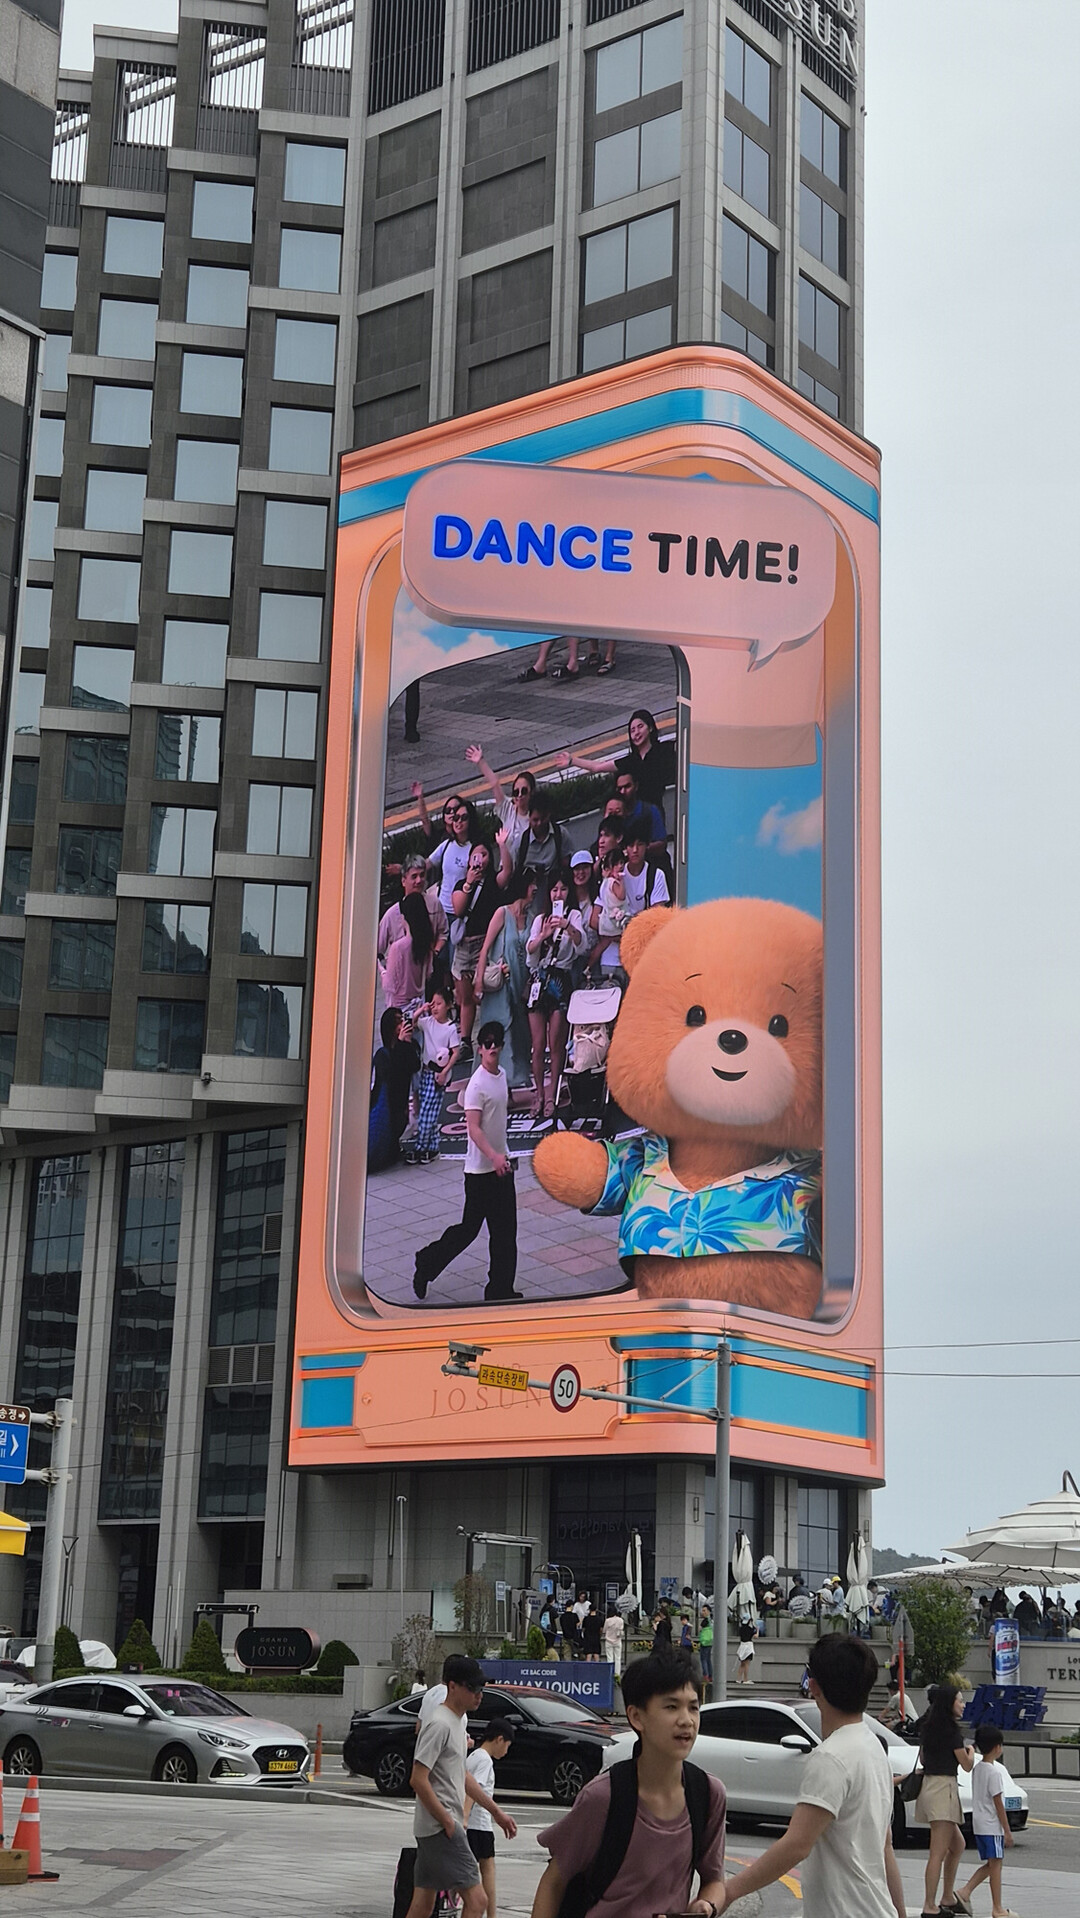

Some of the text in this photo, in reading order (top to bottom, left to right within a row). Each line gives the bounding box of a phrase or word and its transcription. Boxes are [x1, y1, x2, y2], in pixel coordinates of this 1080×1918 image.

[432, 514, 800, 585] DANCE TIME!
[481, 1368, 526, 1387] 과속단속장비
[557, 1378, 574, 1399] 50
[431, 1385, 542, 1417] JOSUN
[252, 1645, 296, 1658] JOSUN
[1047, 1667, 1080, 1680] TER
[546, 1681, 600, 1695] LOUNGE
